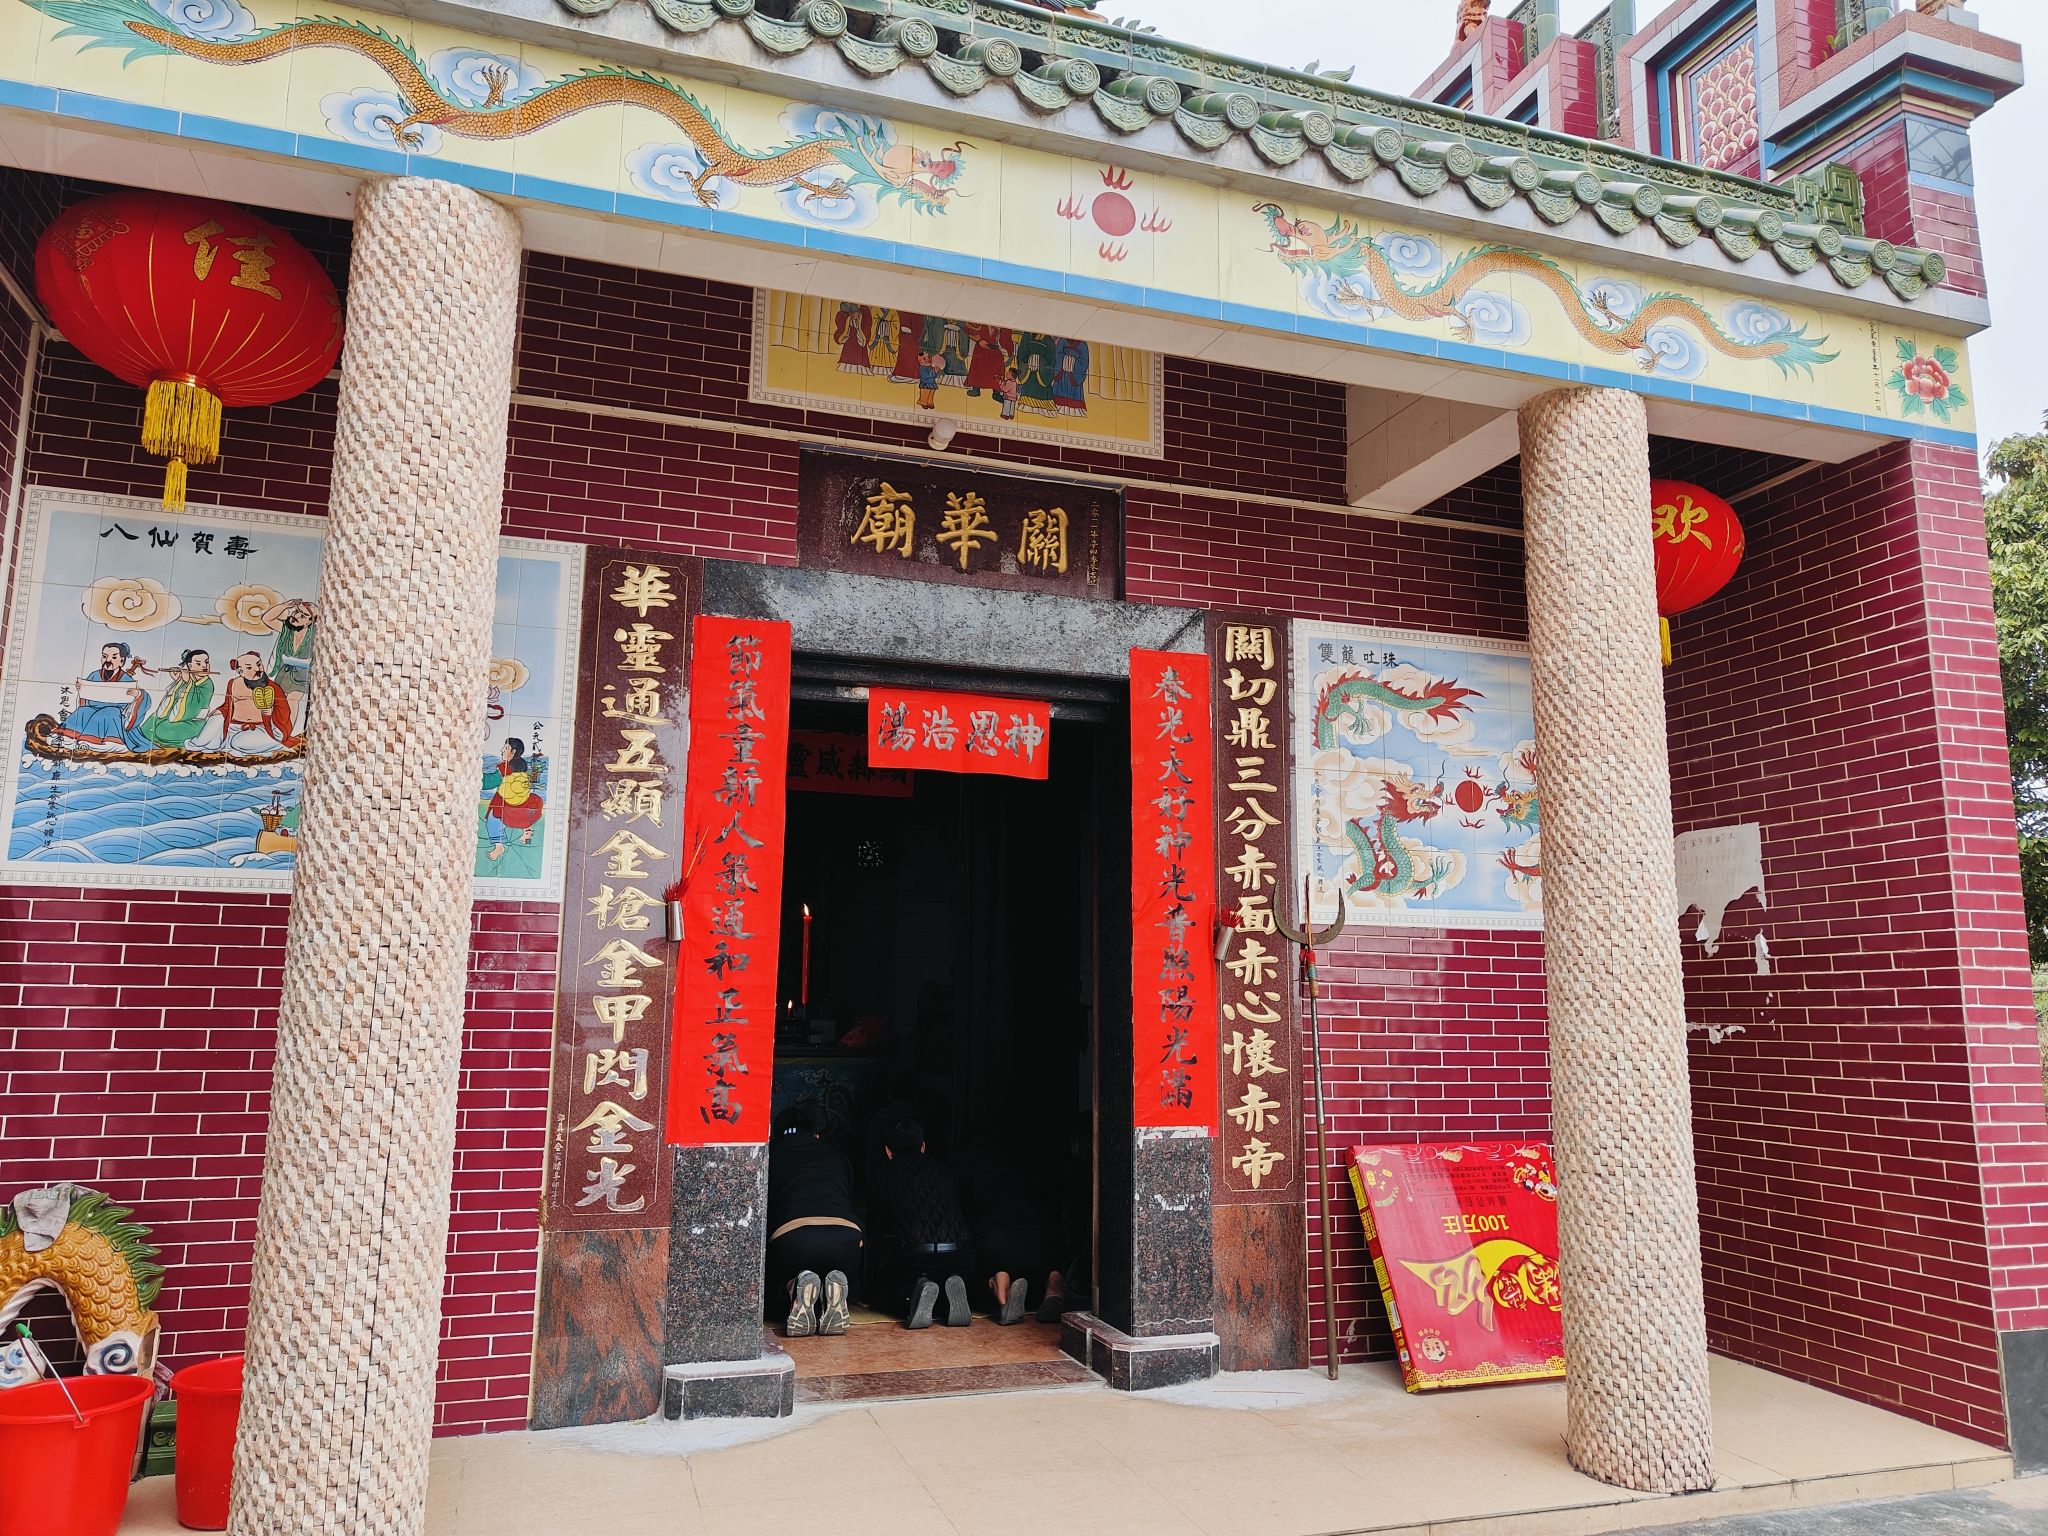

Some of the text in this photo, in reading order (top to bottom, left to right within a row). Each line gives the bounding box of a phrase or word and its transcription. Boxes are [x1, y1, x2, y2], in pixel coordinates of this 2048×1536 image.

[182, 218, 283, 301] 佳
[100, 523, 259, 560] 八仙賀壽
[850, 482, 1069, 574] 關華廟
[1317, 642, 1399, 668] 雙龍吐珠
[878, 701, 1045, 764] 神恩浩蕩
